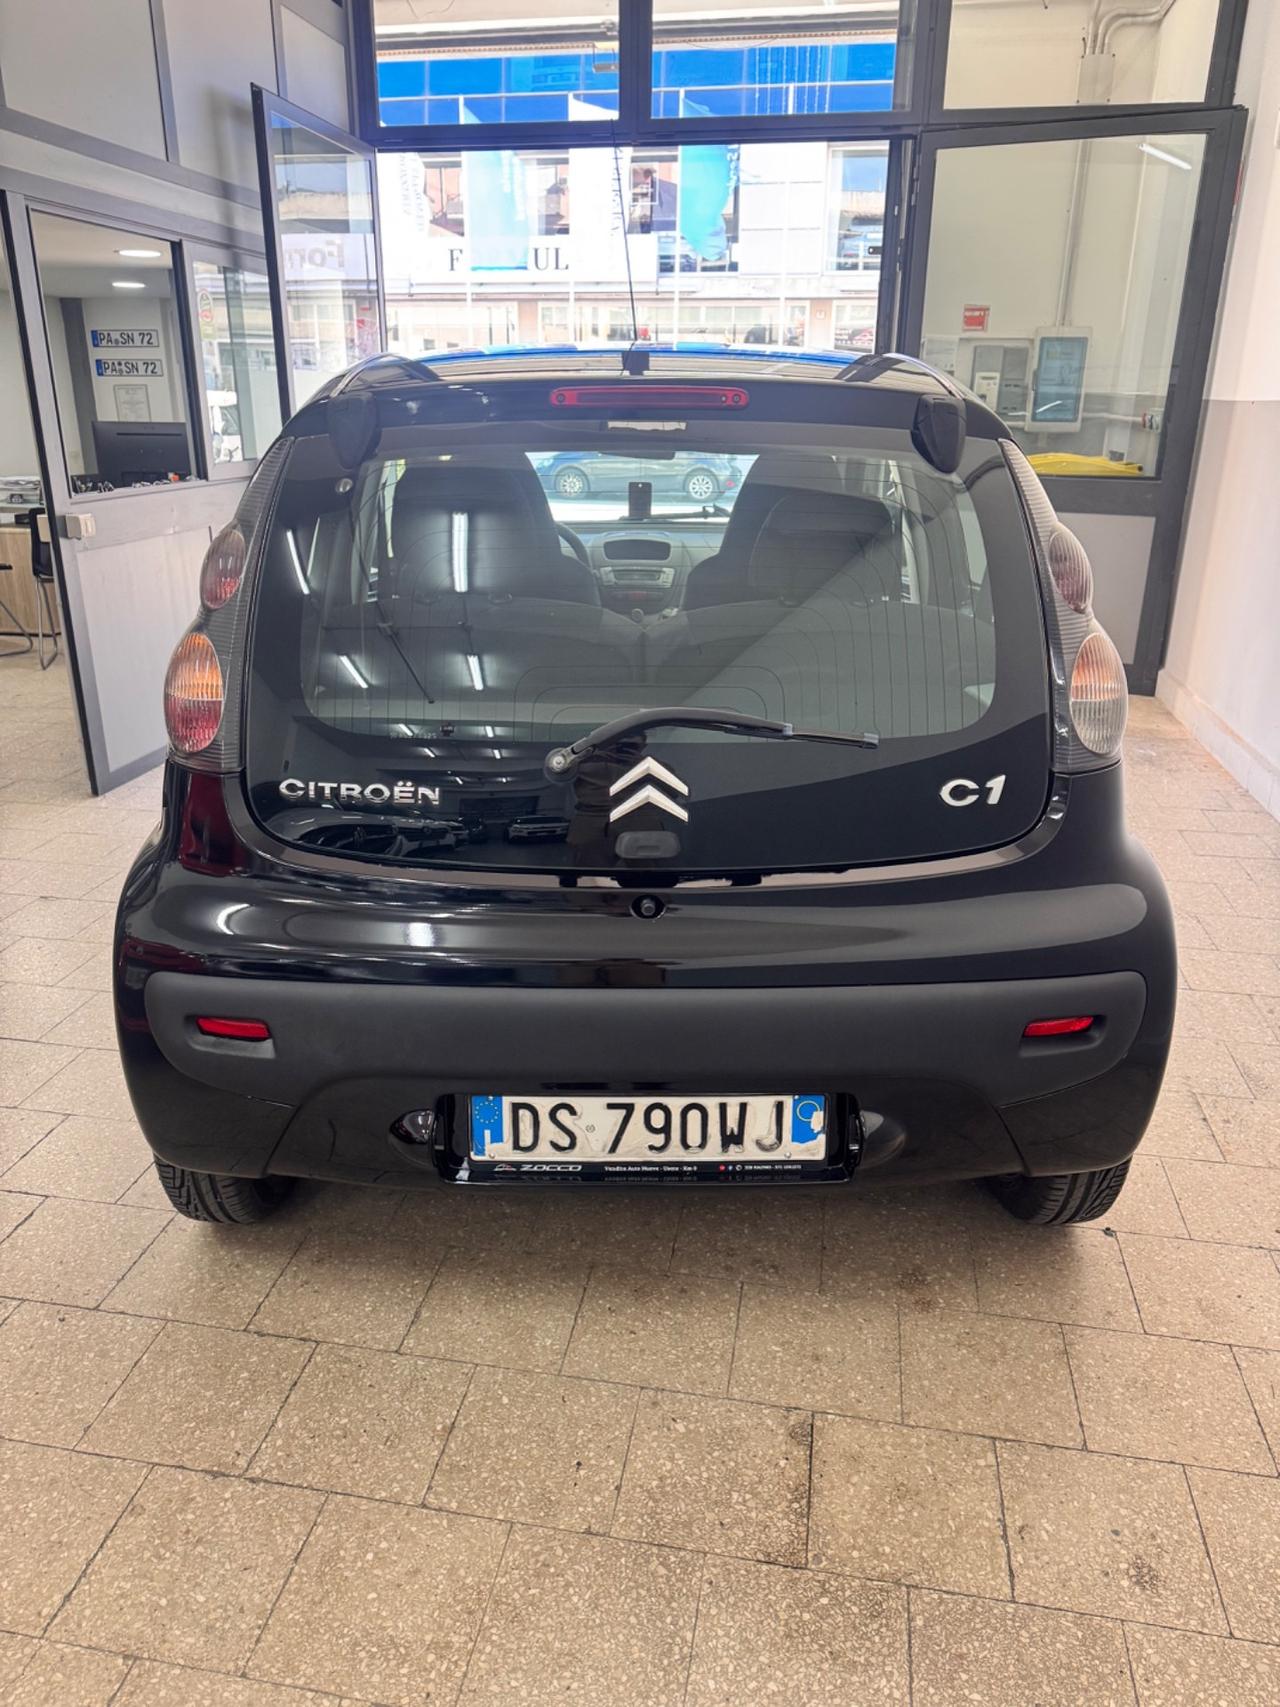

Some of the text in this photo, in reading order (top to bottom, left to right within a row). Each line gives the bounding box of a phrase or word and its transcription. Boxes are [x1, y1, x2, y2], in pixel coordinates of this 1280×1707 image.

[448, 247, 570, 272] FUL
[98, 332, 154, 345] PA SN 72
[103, 361, 158, 374] PA SN 72
[279, 778, 440, 805] CITROËN
[940, 774, 1006, 807] C1
[511, 1100, 784, 1154] DS 790WJ
[520, 1164, 583, 1172] ZOCCO
